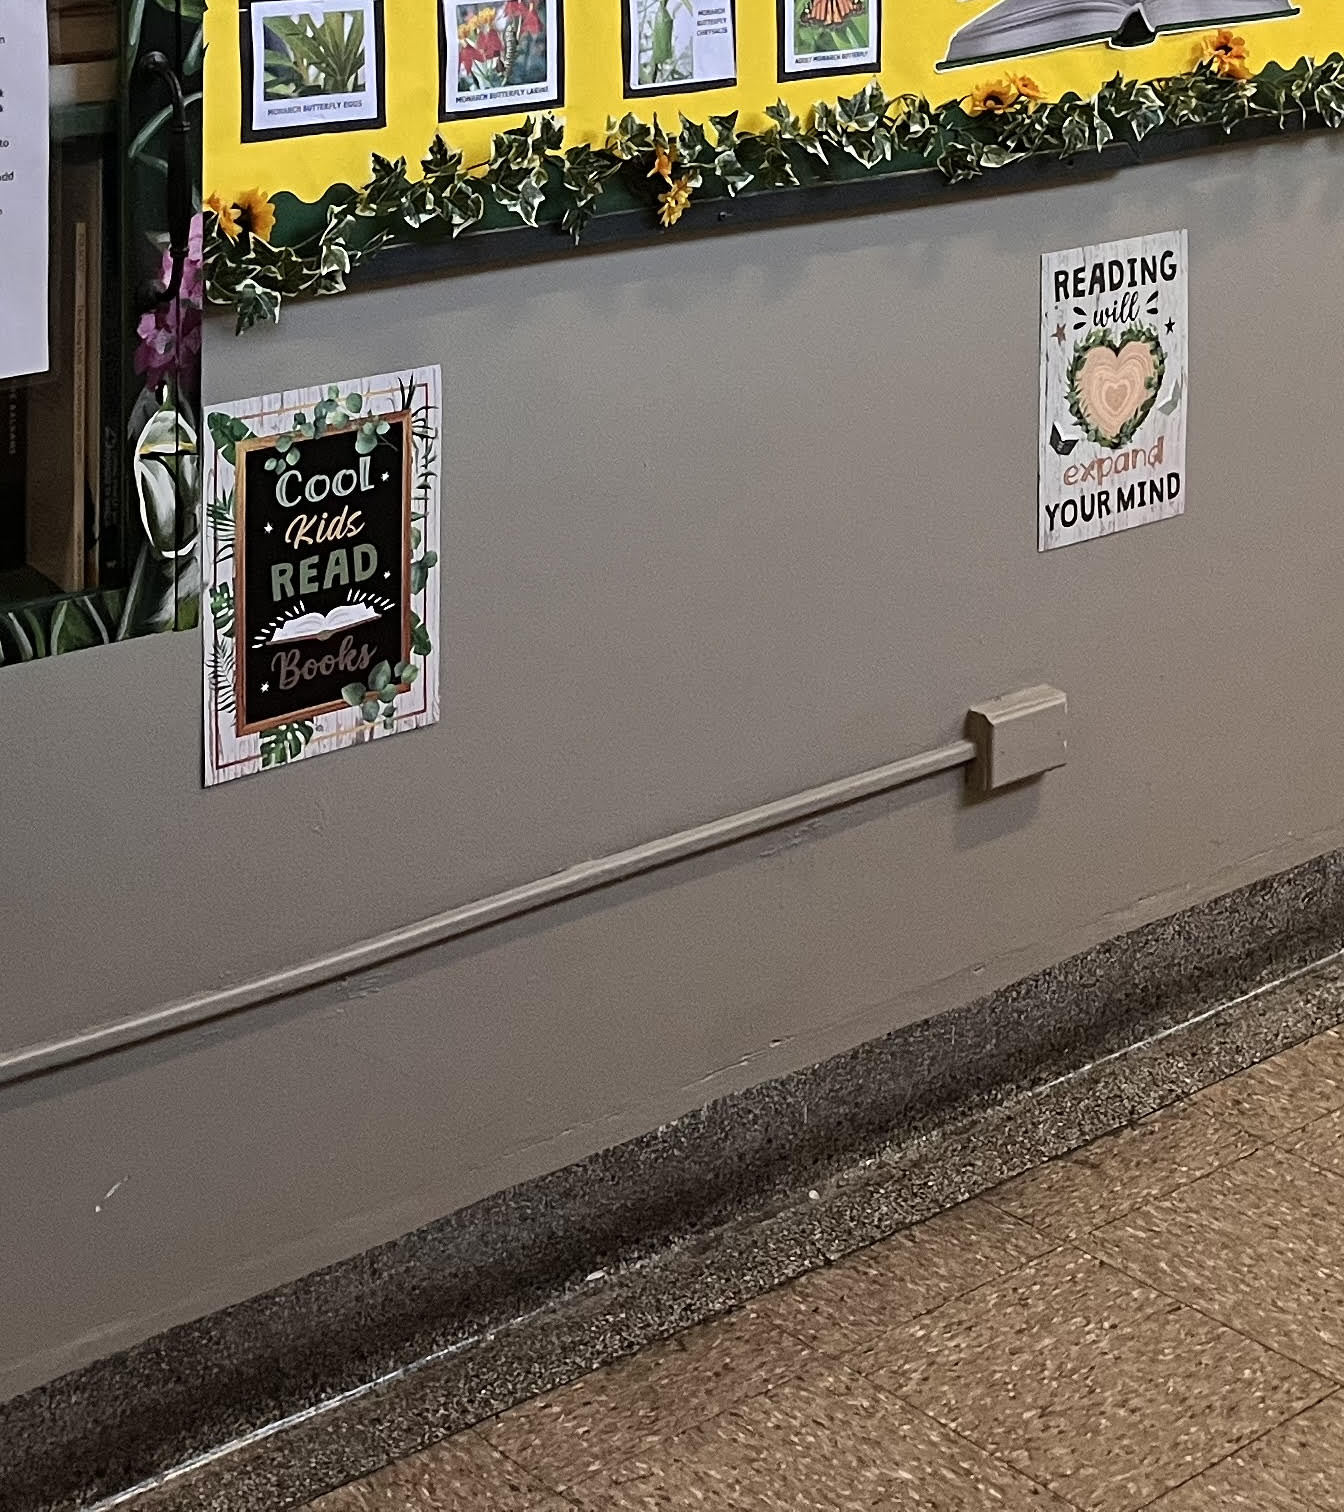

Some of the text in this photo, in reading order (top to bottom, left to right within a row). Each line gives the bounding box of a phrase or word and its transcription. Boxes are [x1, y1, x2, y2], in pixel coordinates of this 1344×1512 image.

[267, 103, 302, 116] MONARCH
[302, 99, 341, 112] BUTTERFLY
[455, 91, 488, 103] MONARCH
[489, 87, 525, 99] BUTTERFLY
[1054, 250, 1177, 302] READING
[1092, 291, 1140, 328] will
[1063, 434, 1165, 486] expand
[284, 504, 366, 550] Kids
[1044, 471, 1181, 532] YOUR MIND
[271, 543, 378, 602] READ
[271, 634, 378, 690] Books
